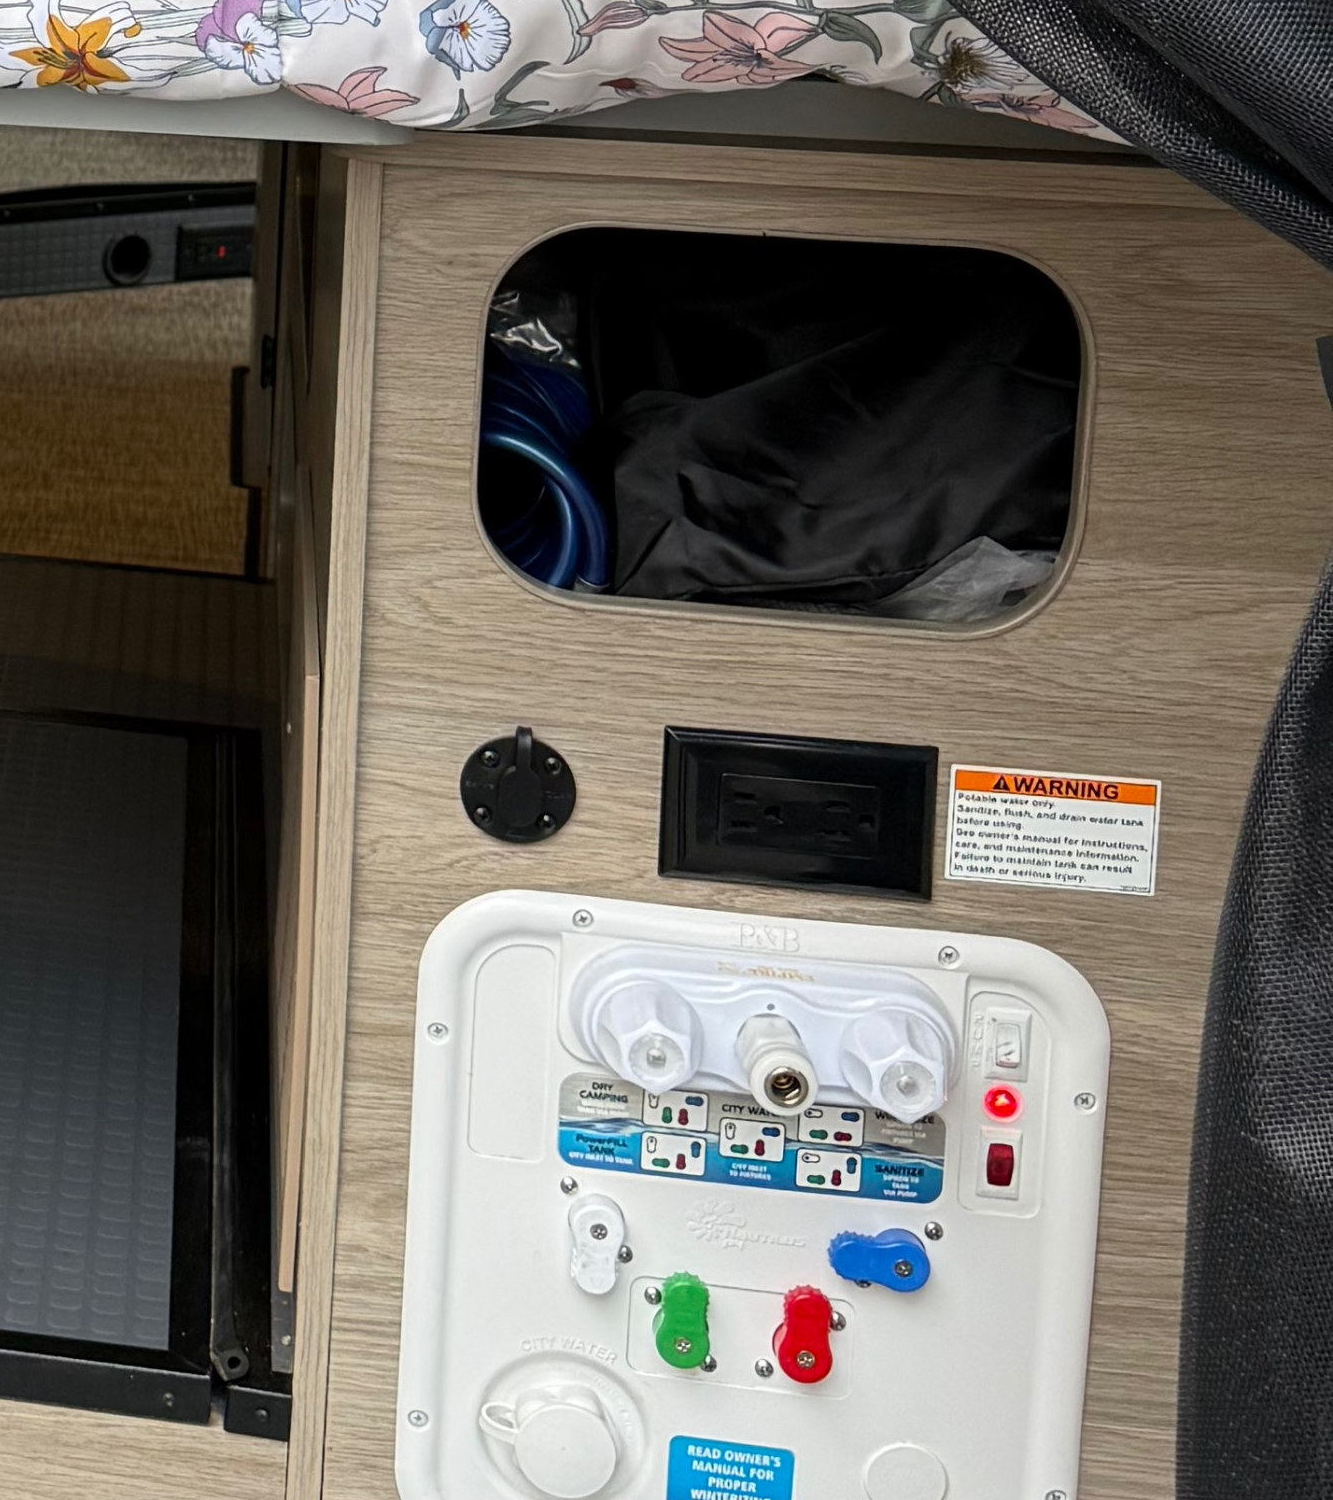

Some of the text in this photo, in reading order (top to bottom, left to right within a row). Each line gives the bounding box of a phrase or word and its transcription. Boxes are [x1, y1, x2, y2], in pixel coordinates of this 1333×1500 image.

[1014, 776, 1119, 800] WARNING
[958, 792, 997, 803] Potable
[1001, 797, 1029, 806] water
[956, 816, 1024, 831] before using.
[957, 804, 1144, 827] Sanitize, flush, and drain water tank
[956, 827, 1148, 852] See owner's manual for instructions,
[954, 851, 1133, 874] Failure to maintain tank can result
[955, 841, 1139, 863] care, and maintenance information.
[954, 863, 1086, 884] in death or serious injury.
[579, 1090, 629, 1104] CAMPING
[591, 1082, 614, 1092] DRY
[721, 1104, 745, 1114] CITY
[588, 1144, 615, 1156] TANK
[874, 1164, 925, 1177] SANITIZE
[521, 1336, 619, 1364] CITY WATER
[687, 1444, 781, 1468] READ OWNER'S
[691, 1460, 775, 1481] MANUAL FOR
[707, 1476, 757, 1493] PROPER
